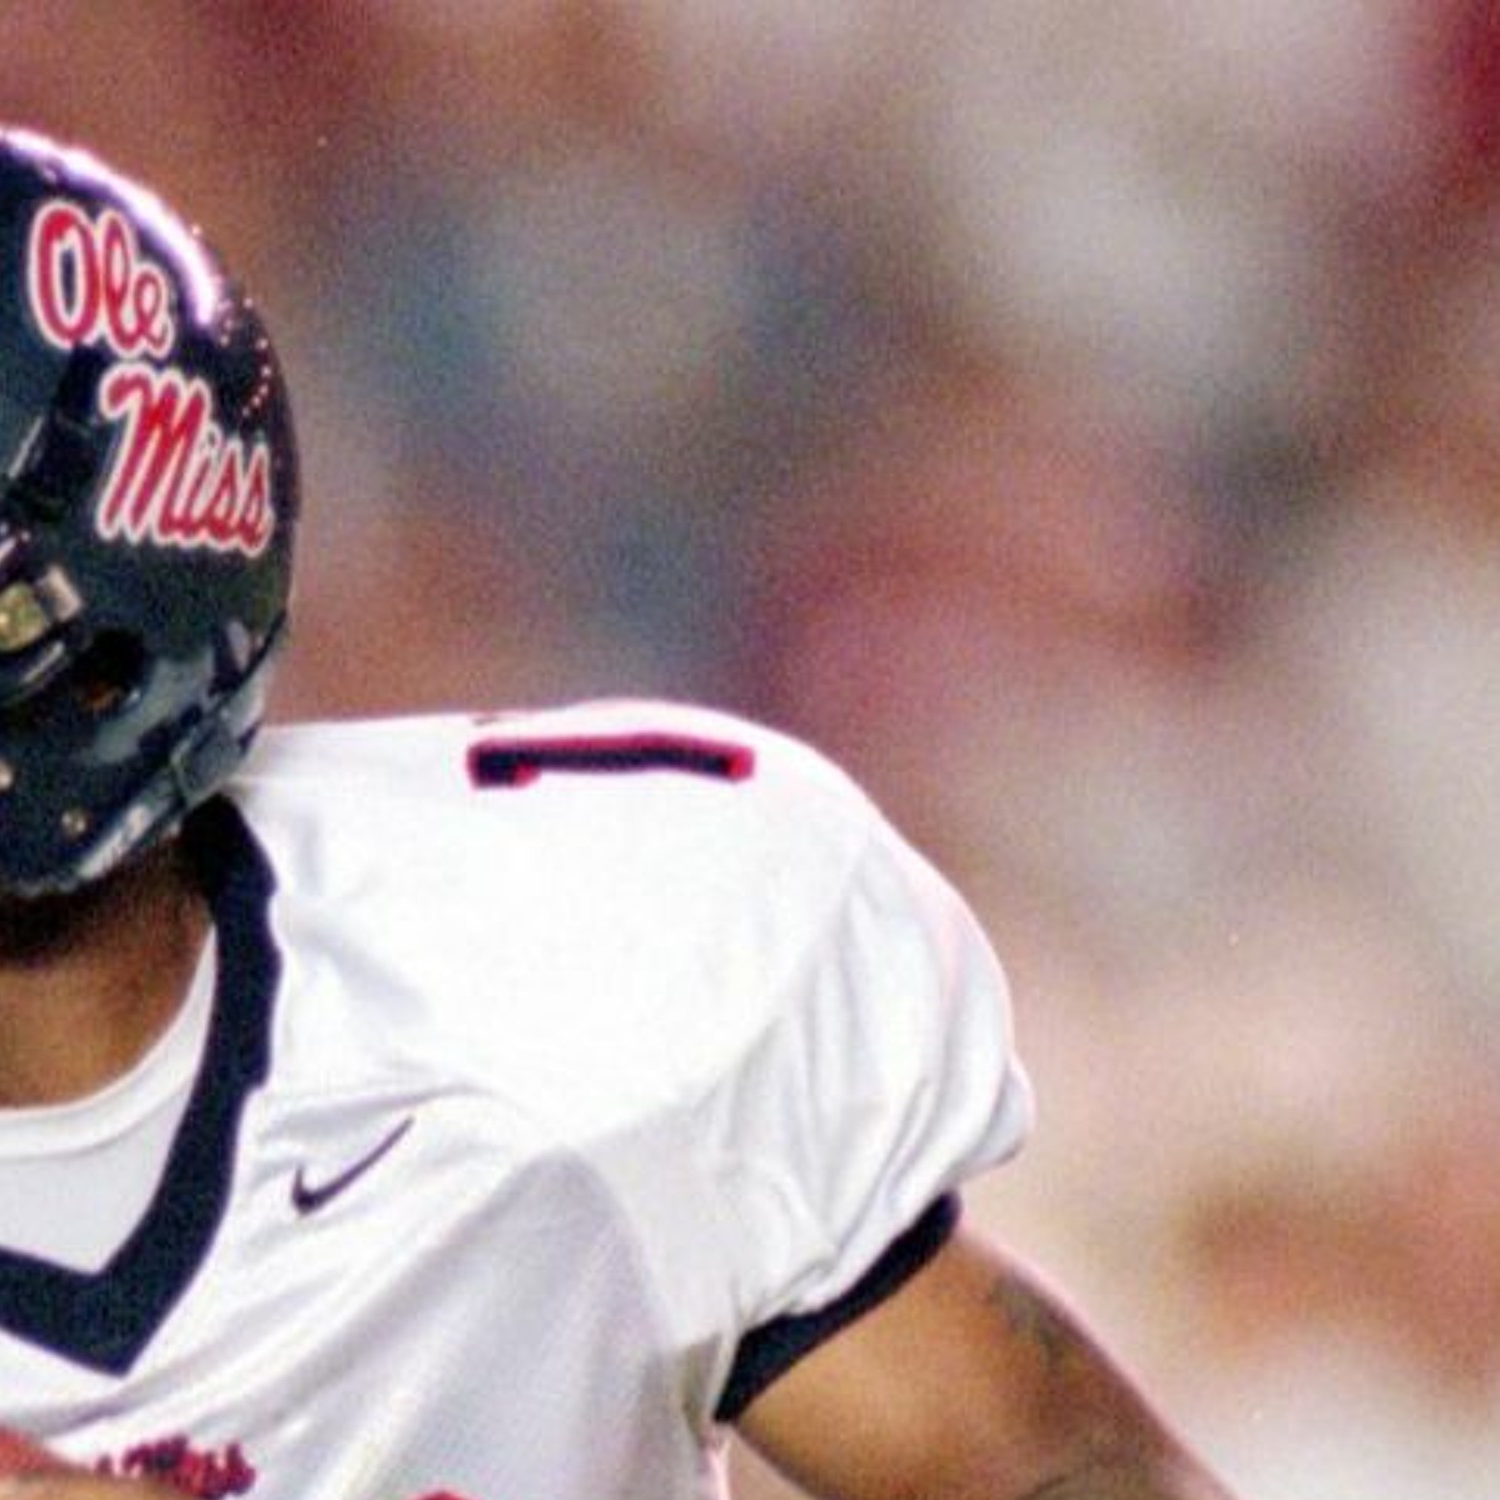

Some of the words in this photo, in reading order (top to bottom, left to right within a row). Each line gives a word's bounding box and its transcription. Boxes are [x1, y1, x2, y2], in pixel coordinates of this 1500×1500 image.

[27, 199, 175, 358] Ole
[96, 360, 276, 557] Miss
[467, 732, 755, 790] 1
